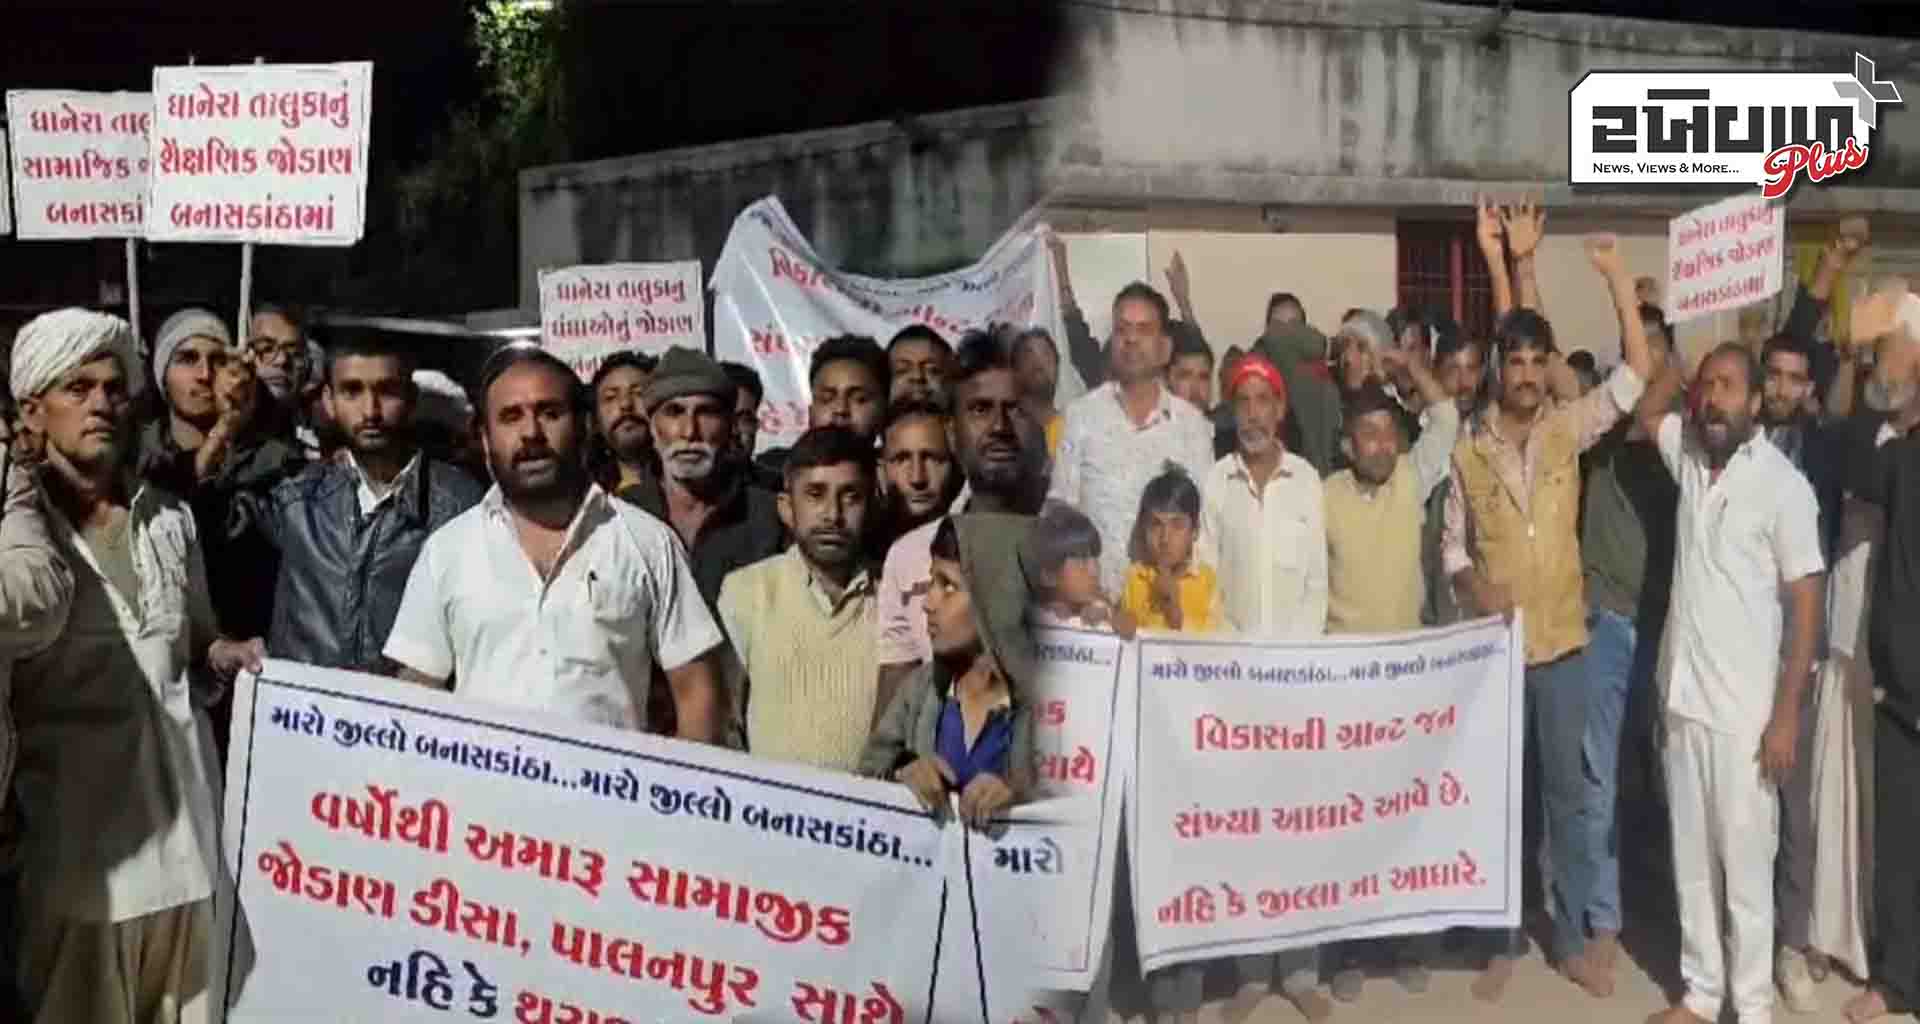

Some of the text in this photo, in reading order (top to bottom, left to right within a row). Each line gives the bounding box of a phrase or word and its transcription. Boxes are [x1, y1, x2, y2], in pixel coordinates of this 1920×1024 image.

[30, 102, 103, 133] ધાનેરા
[168, 80, 350, 128] ધાનેરા તાલુકાનું
[23, 149, 131, 179] સામાજિક
[266, 137, 353, 175] જોડાણ
[170, 192, 335, 232] બનાસકાંઠામાં
[1194, 704, 1456, 751] વિકાસની ગ્રાન્ટ જન
[272, 705, 325, 736] મારો
[333, 717, 407, 752] જીલ્લો
[649, 785, 731, 824] જીલ્લો
[742, 802, 933, 868] બનાસકાંઠા...
[1173, 803, 1261, 838] સંખ્યા
[1272, 792, 1365, 833] આધારે
[1374, 777, 1430, 817] આવે
[311, 783, 449, 853] વર્ષોથી
[626, 859, 851, 946] સામાજીક
[994, 836, 1063, 875] મારો
[1157, 884, 1215, 923] નહિ
[1220, 881, 1248, 918] કે
[1256, 880, 1340, 918] જીલ્લા
[1348, 874, 1380, 898] ના
[257, 841, 396, 918] જોડાણ
[409, 878, 532, 957] ડીસા,
[551, 920, 760, 1015] પાલનપુર
[367, 949, 455, 1011] નહિ
[463, 961, 498, 1019] કે
